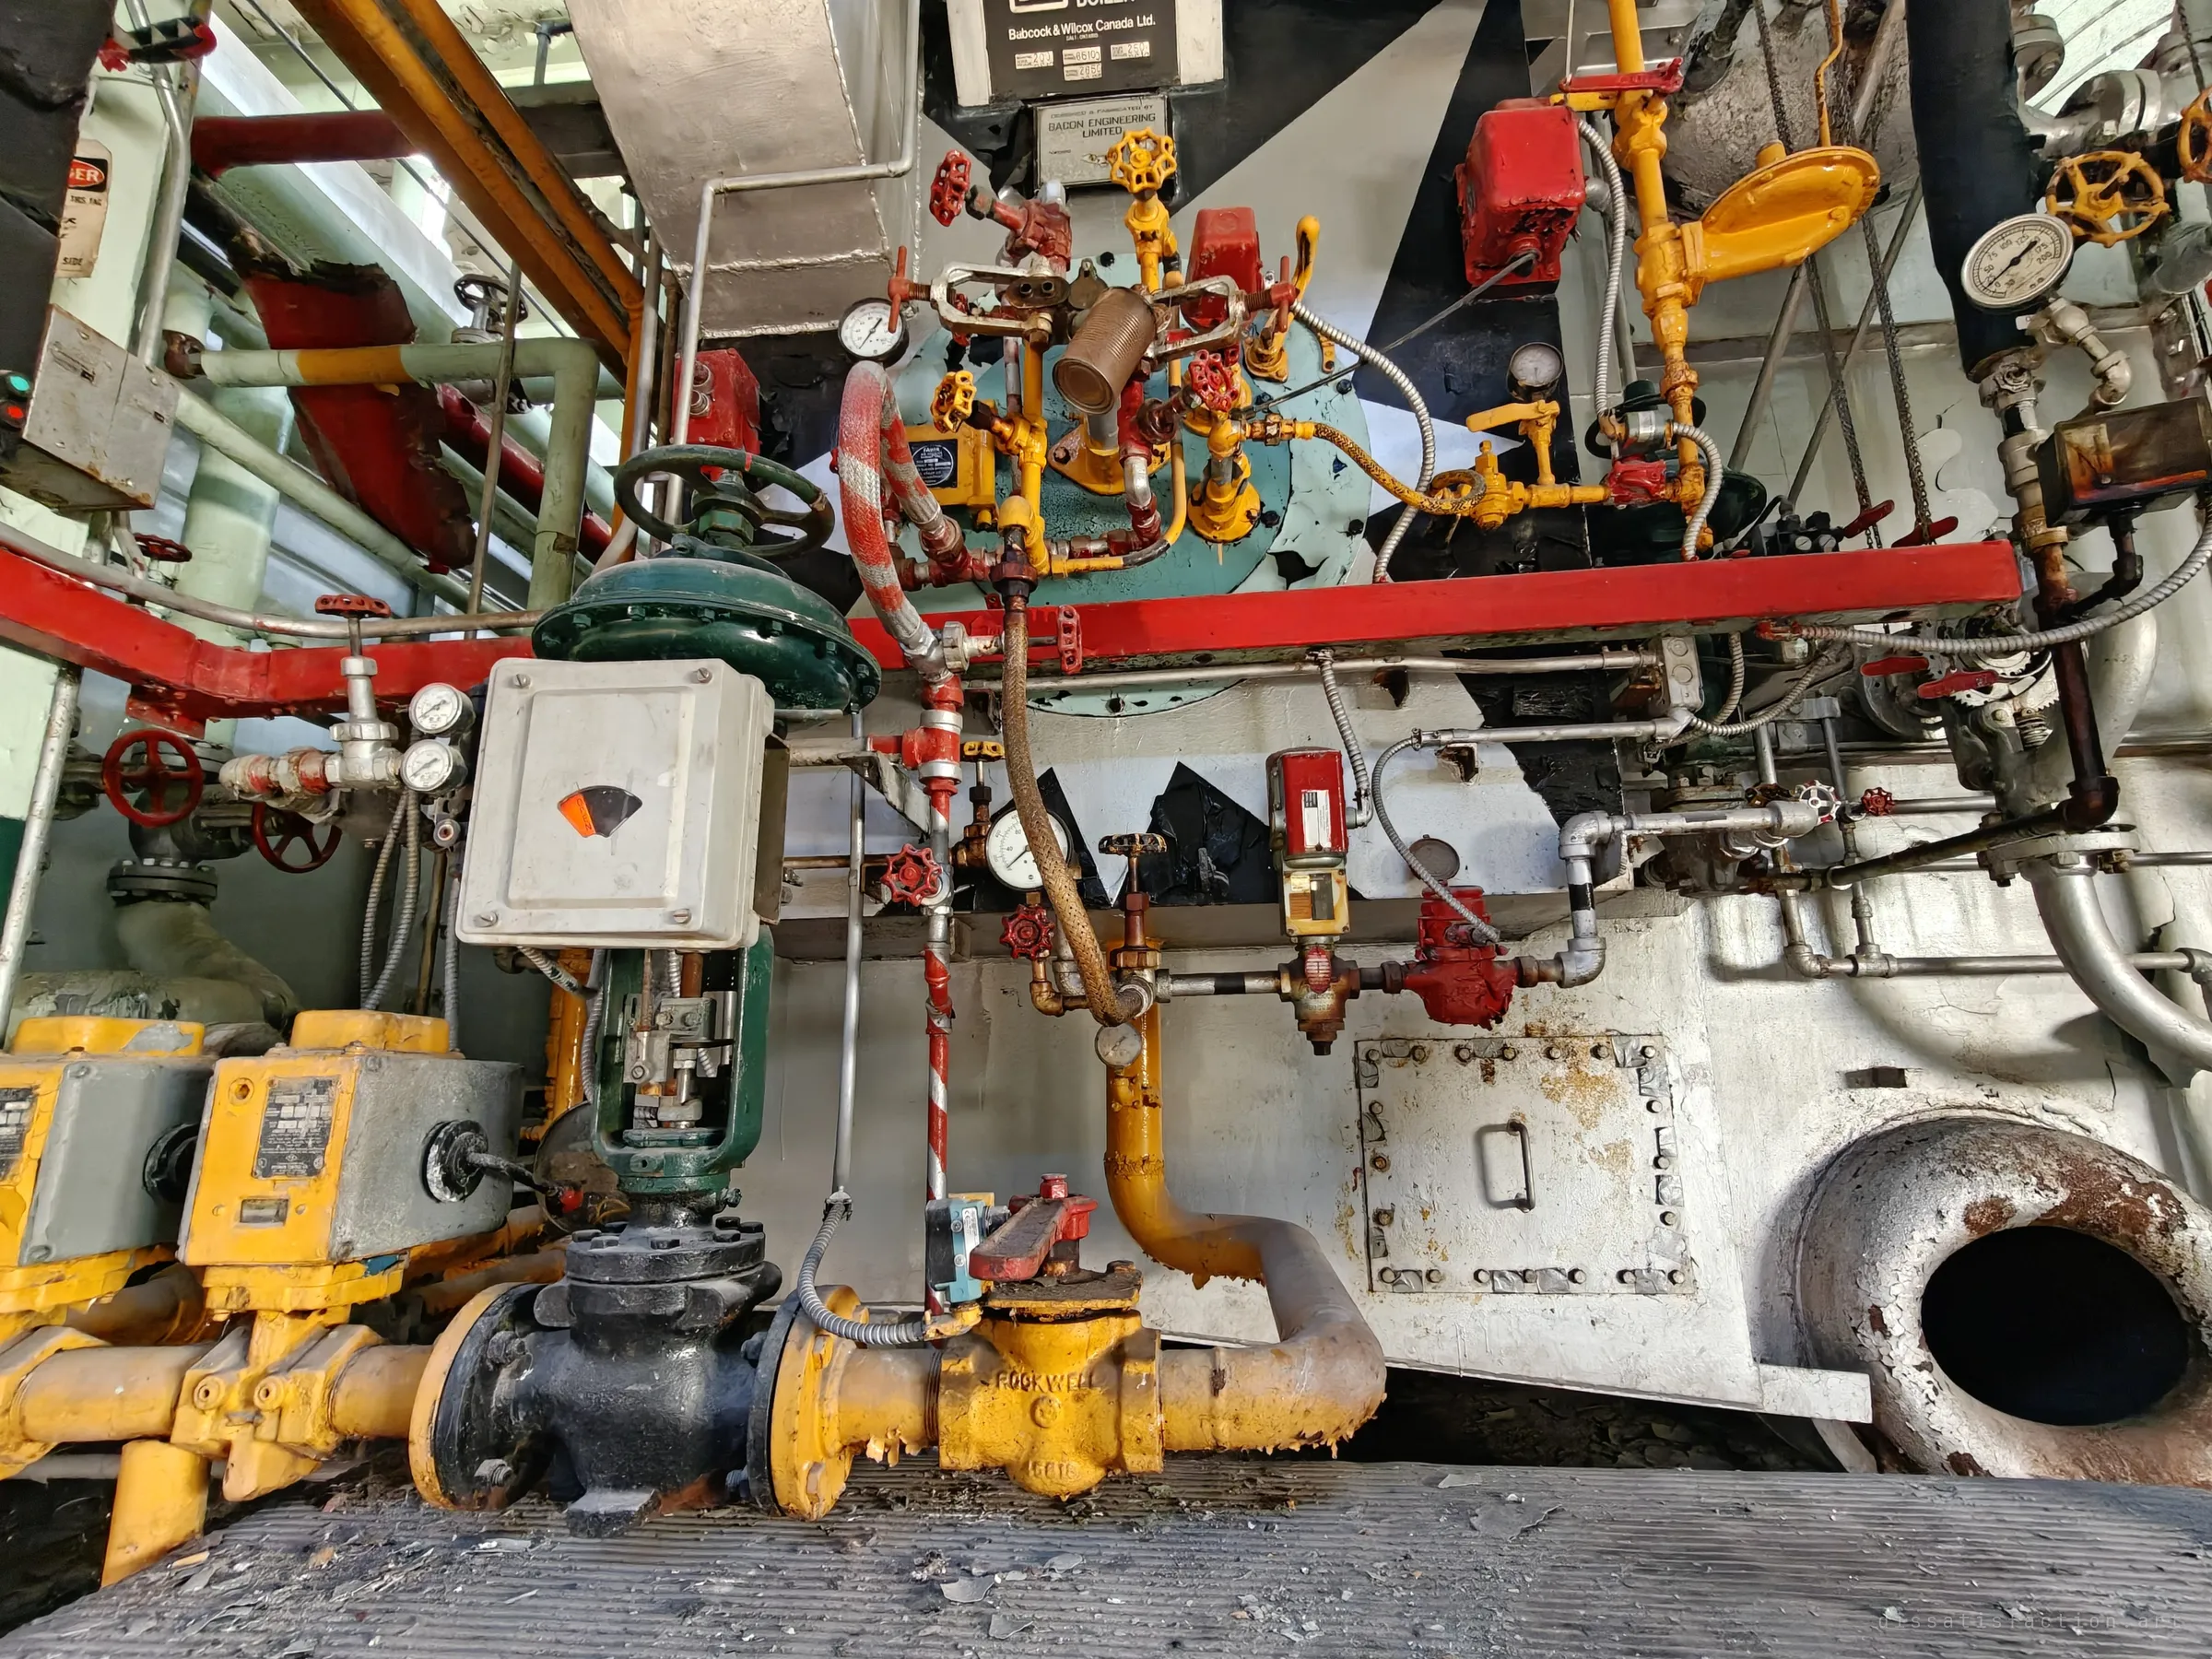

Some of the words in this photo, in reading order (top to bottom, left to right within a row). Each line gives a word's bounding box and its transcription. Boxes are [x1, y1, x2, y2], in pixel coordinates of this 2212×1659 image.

[1008, 25, 1053, 41] Babcock
[1053, 25, 1061, 36] &
[1061, 21, 1094, 35] Wilcox
[1095, 16, 1134, 32] Canada
[1136, 14, 1157, 28] Ltd.
[1048, 120, 1084, 132] BACON
[1088, 113, 1156, 127] ENGINEERING
[1082, 125, 1123, 138] LIMITED
[2036, 252, 2053, 264] 200
[1983, 265, 1994, 274] 50
